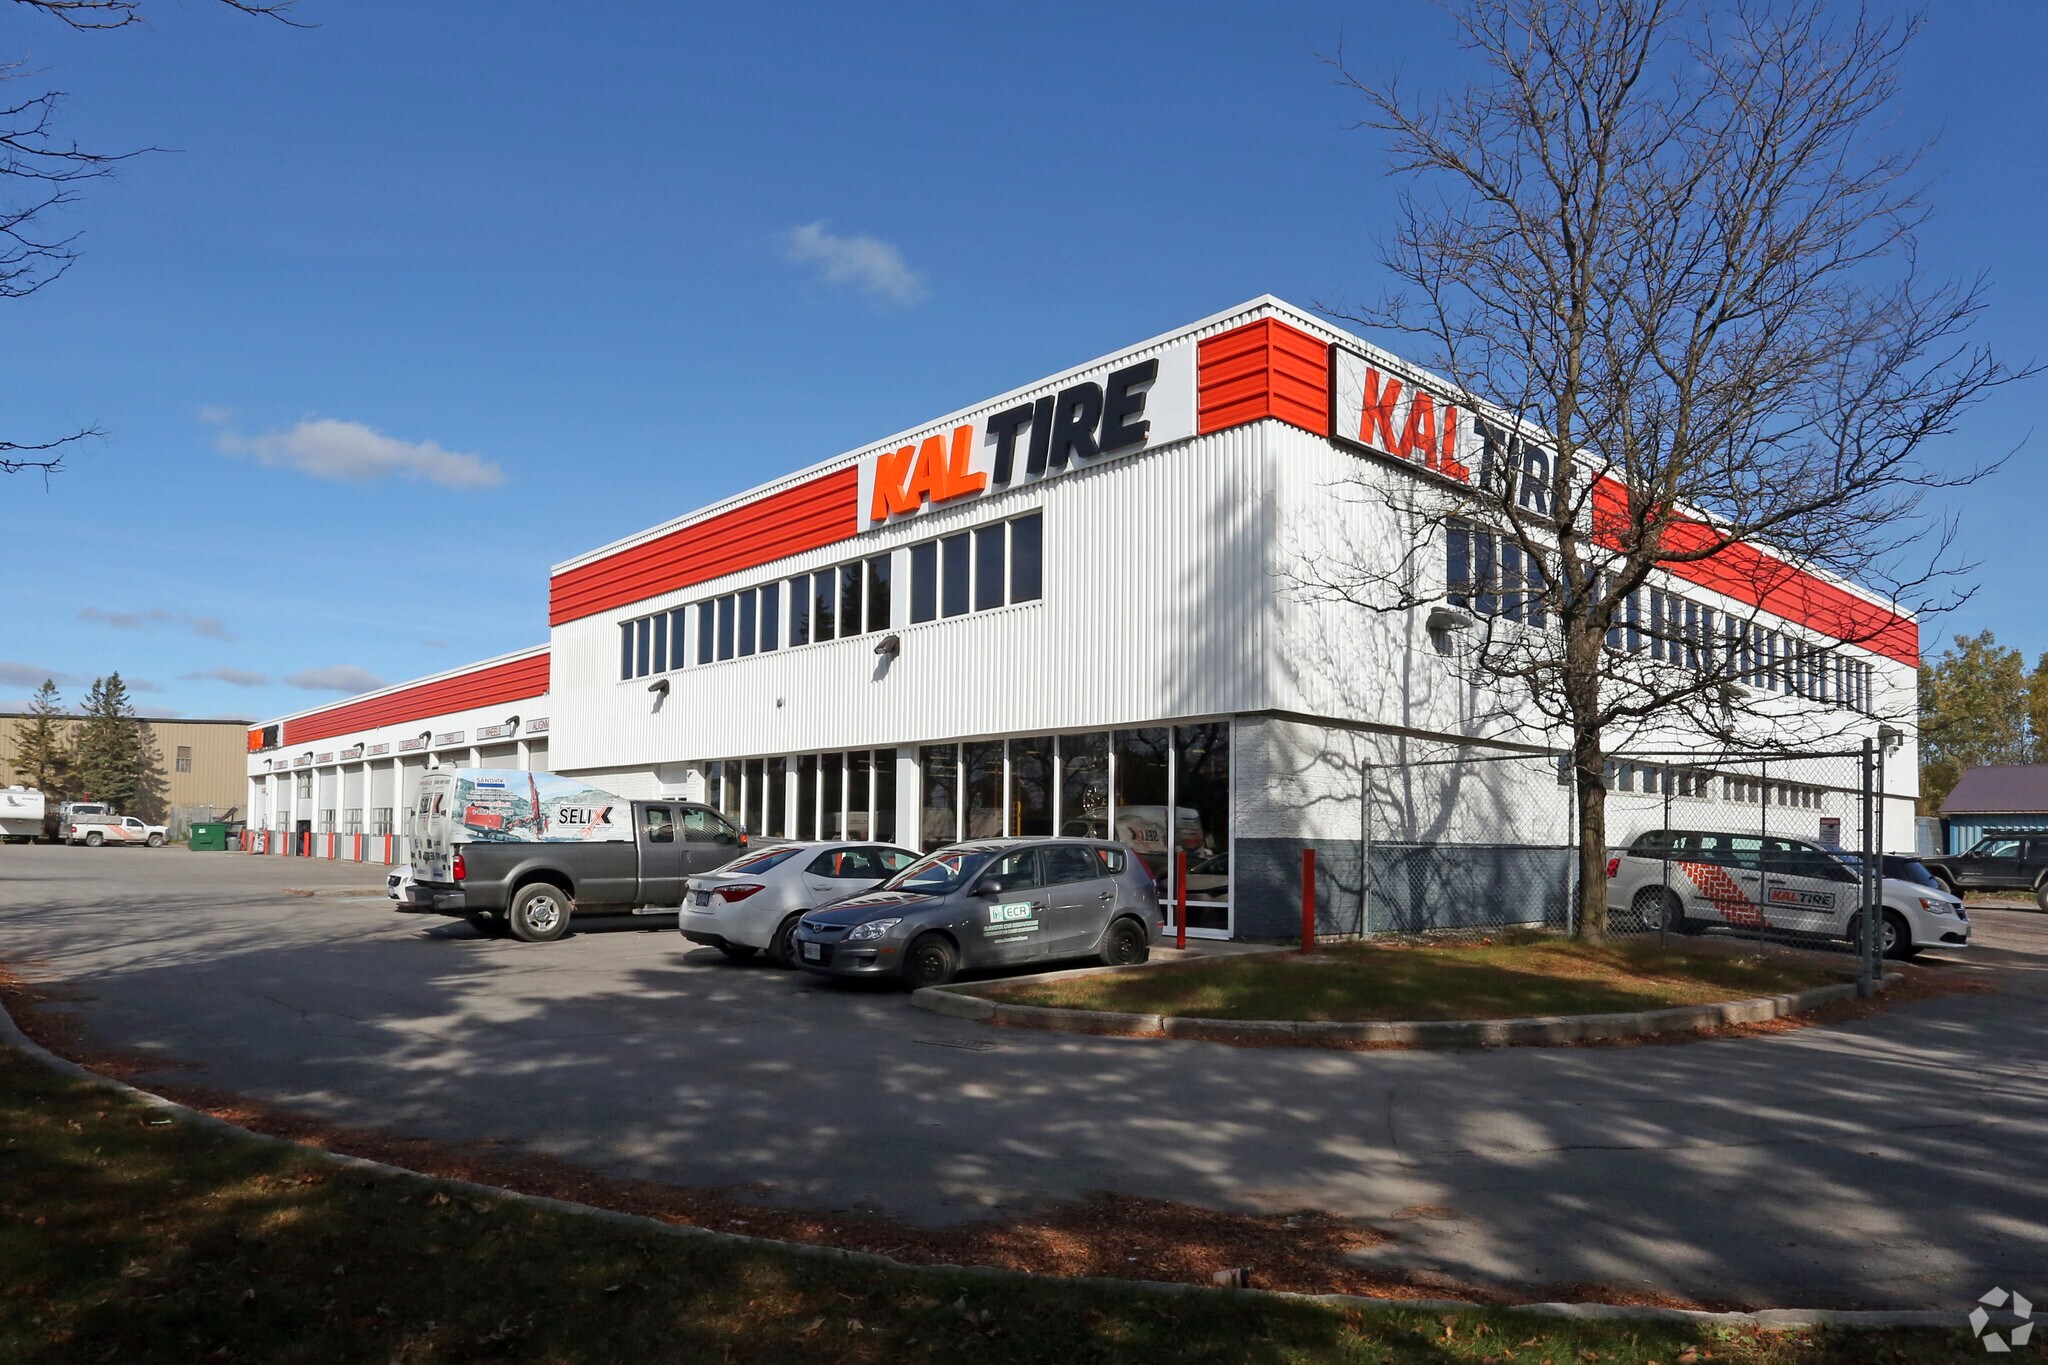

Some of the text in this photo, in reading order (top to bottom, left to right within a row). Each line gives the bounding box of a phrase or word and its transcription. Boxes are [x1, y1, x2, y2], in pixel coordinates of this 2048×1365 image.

[871, 358, 1160, 521] KAL TIRE
[1359, 367, 1470, 484] KAL
[1006, 905, 1027, 917] ECR
[1771, 890, 1832, 906] KAL TIRE
